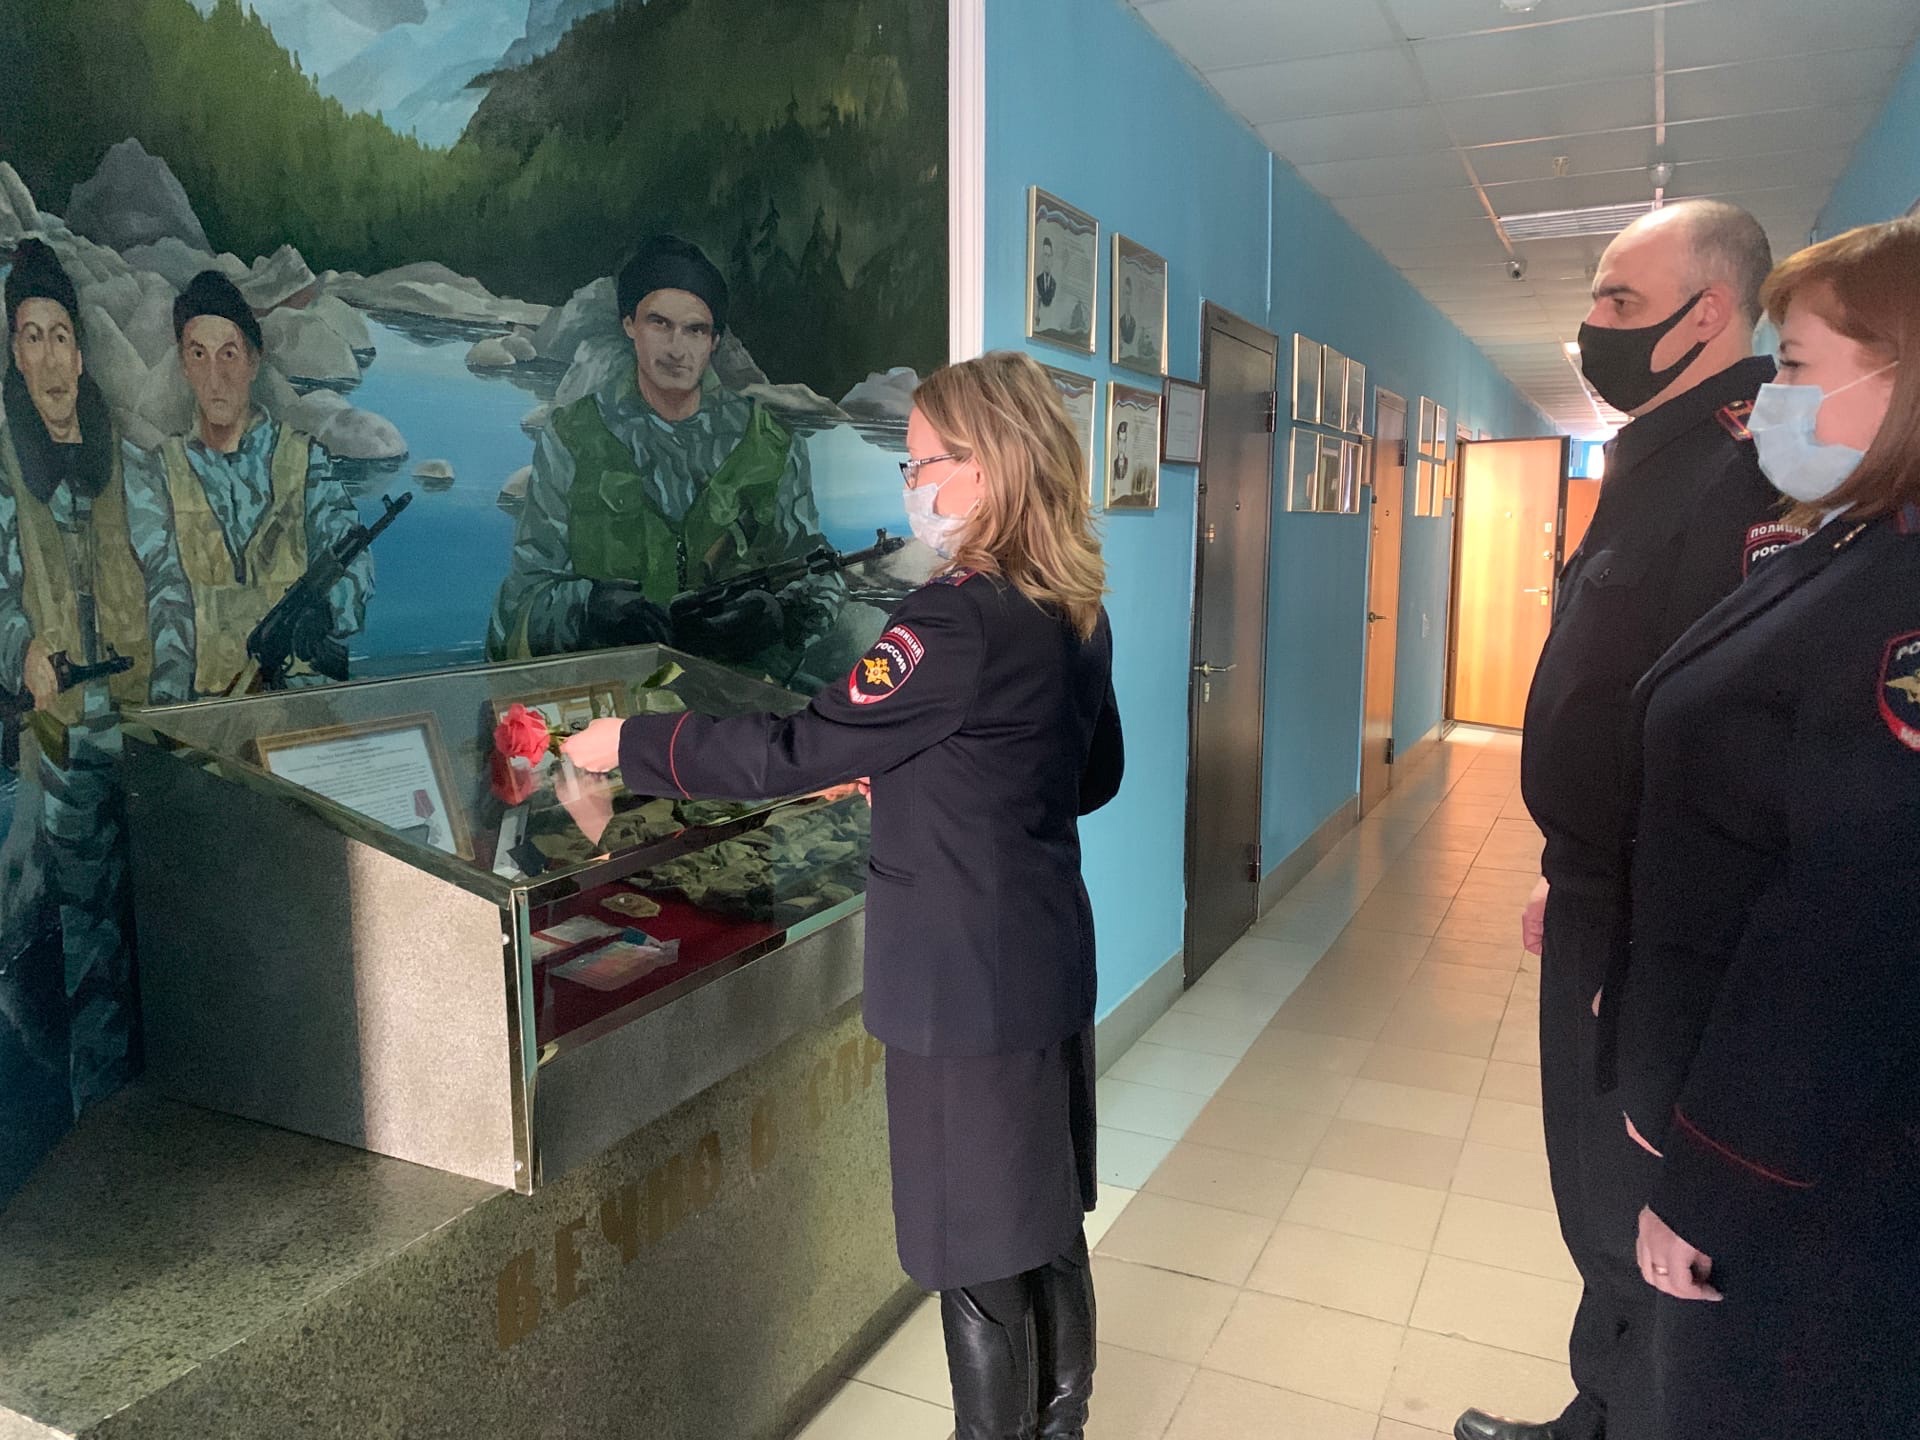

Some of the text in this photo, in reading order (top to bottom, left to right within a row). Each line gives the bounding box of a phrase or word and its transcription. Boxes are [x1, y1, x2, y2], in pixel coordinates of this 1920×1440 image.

[1750, 523, 1809, 539] ПОЛИЦИЯ
[874, 642, 907, 674] РОССИЯ
[889, 626, 922, 658] ПОЛИЦИЯ
